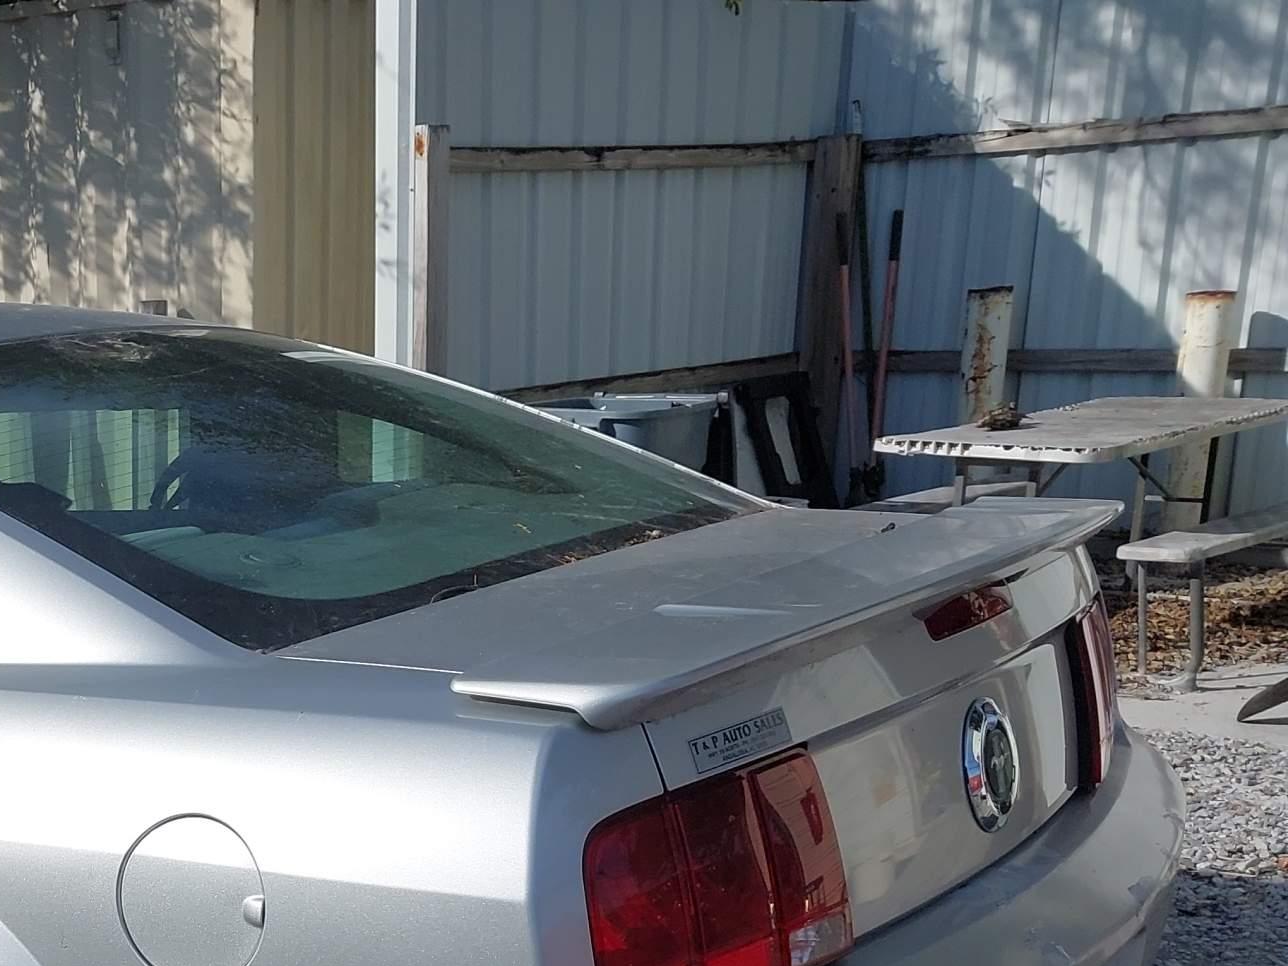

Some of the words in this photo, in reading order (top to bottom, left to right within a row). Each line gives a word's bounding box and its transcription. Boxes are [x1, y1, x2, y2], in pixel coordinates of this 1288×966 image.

[692, 741, 700, 755] T
[711, 735, 719, 749] P
[723, 724, 752, 745] AUTO
